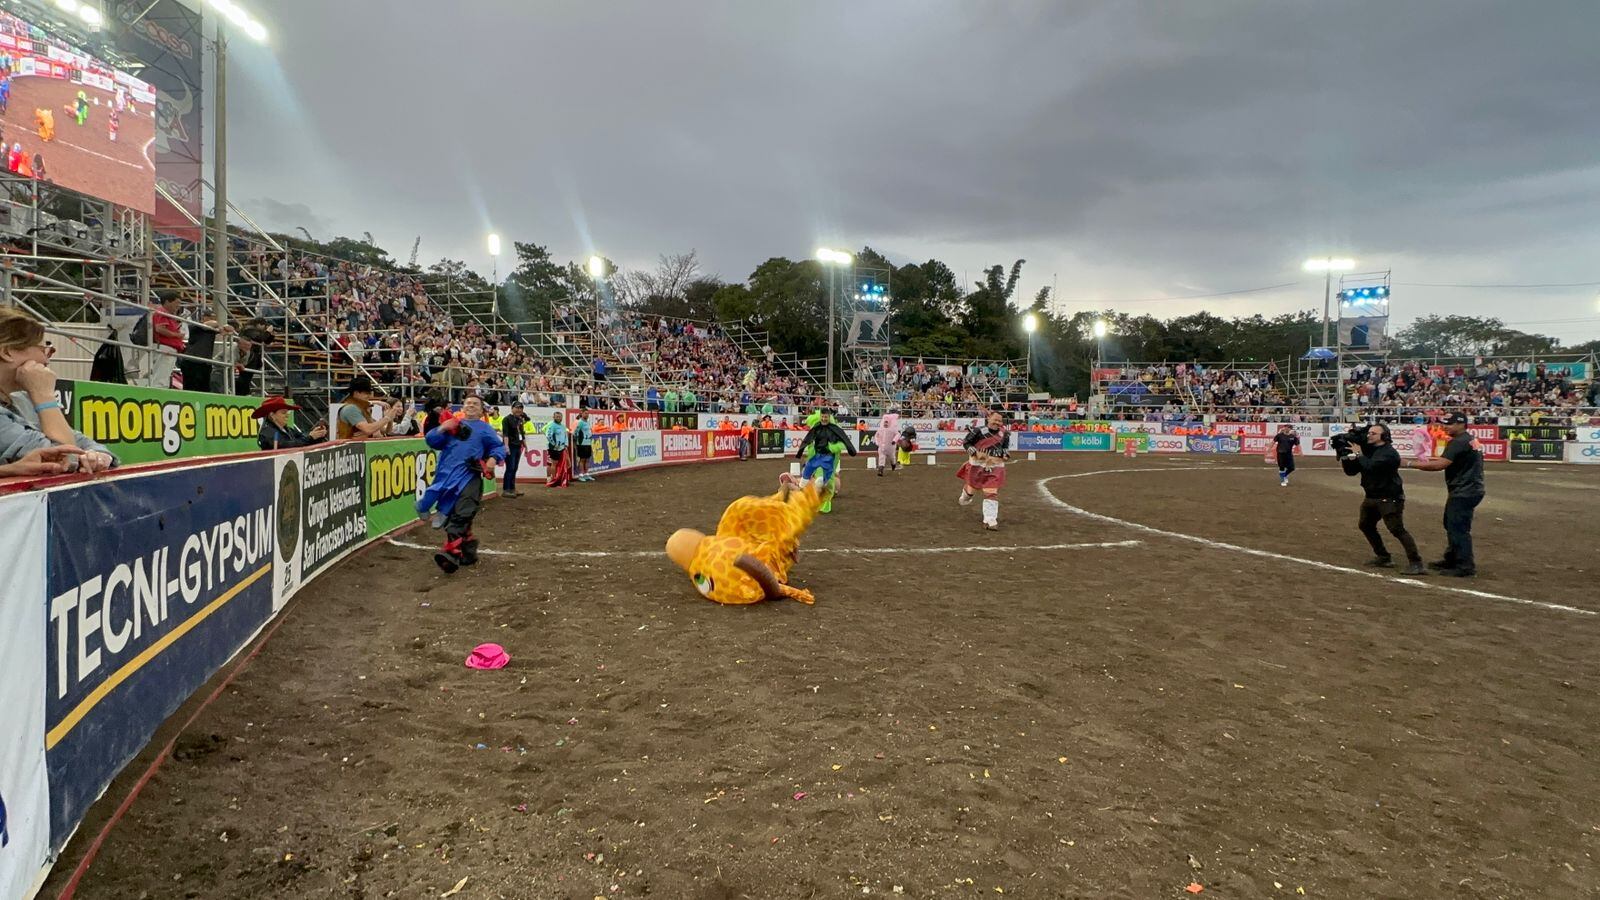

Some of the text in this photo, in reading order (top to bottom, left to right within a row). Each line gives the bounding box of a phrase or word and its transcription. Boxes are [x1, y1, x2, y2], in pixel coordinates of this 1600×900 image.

[82, 398, 195, 453] monge
[663, 434, 702, 451] PEDREGAL
[304, 449, 365, 489] Escuela de Medicina y
[370, 452, 437, 501] monge
[329, 480, 361, 515] Veterinaria
[303, 539, 315, 571] San
[315, 524, 345, 562] Francisco
[345, 516, 353, 542] de
[50, 504, 273, 699] TECNI-GYPSUM
